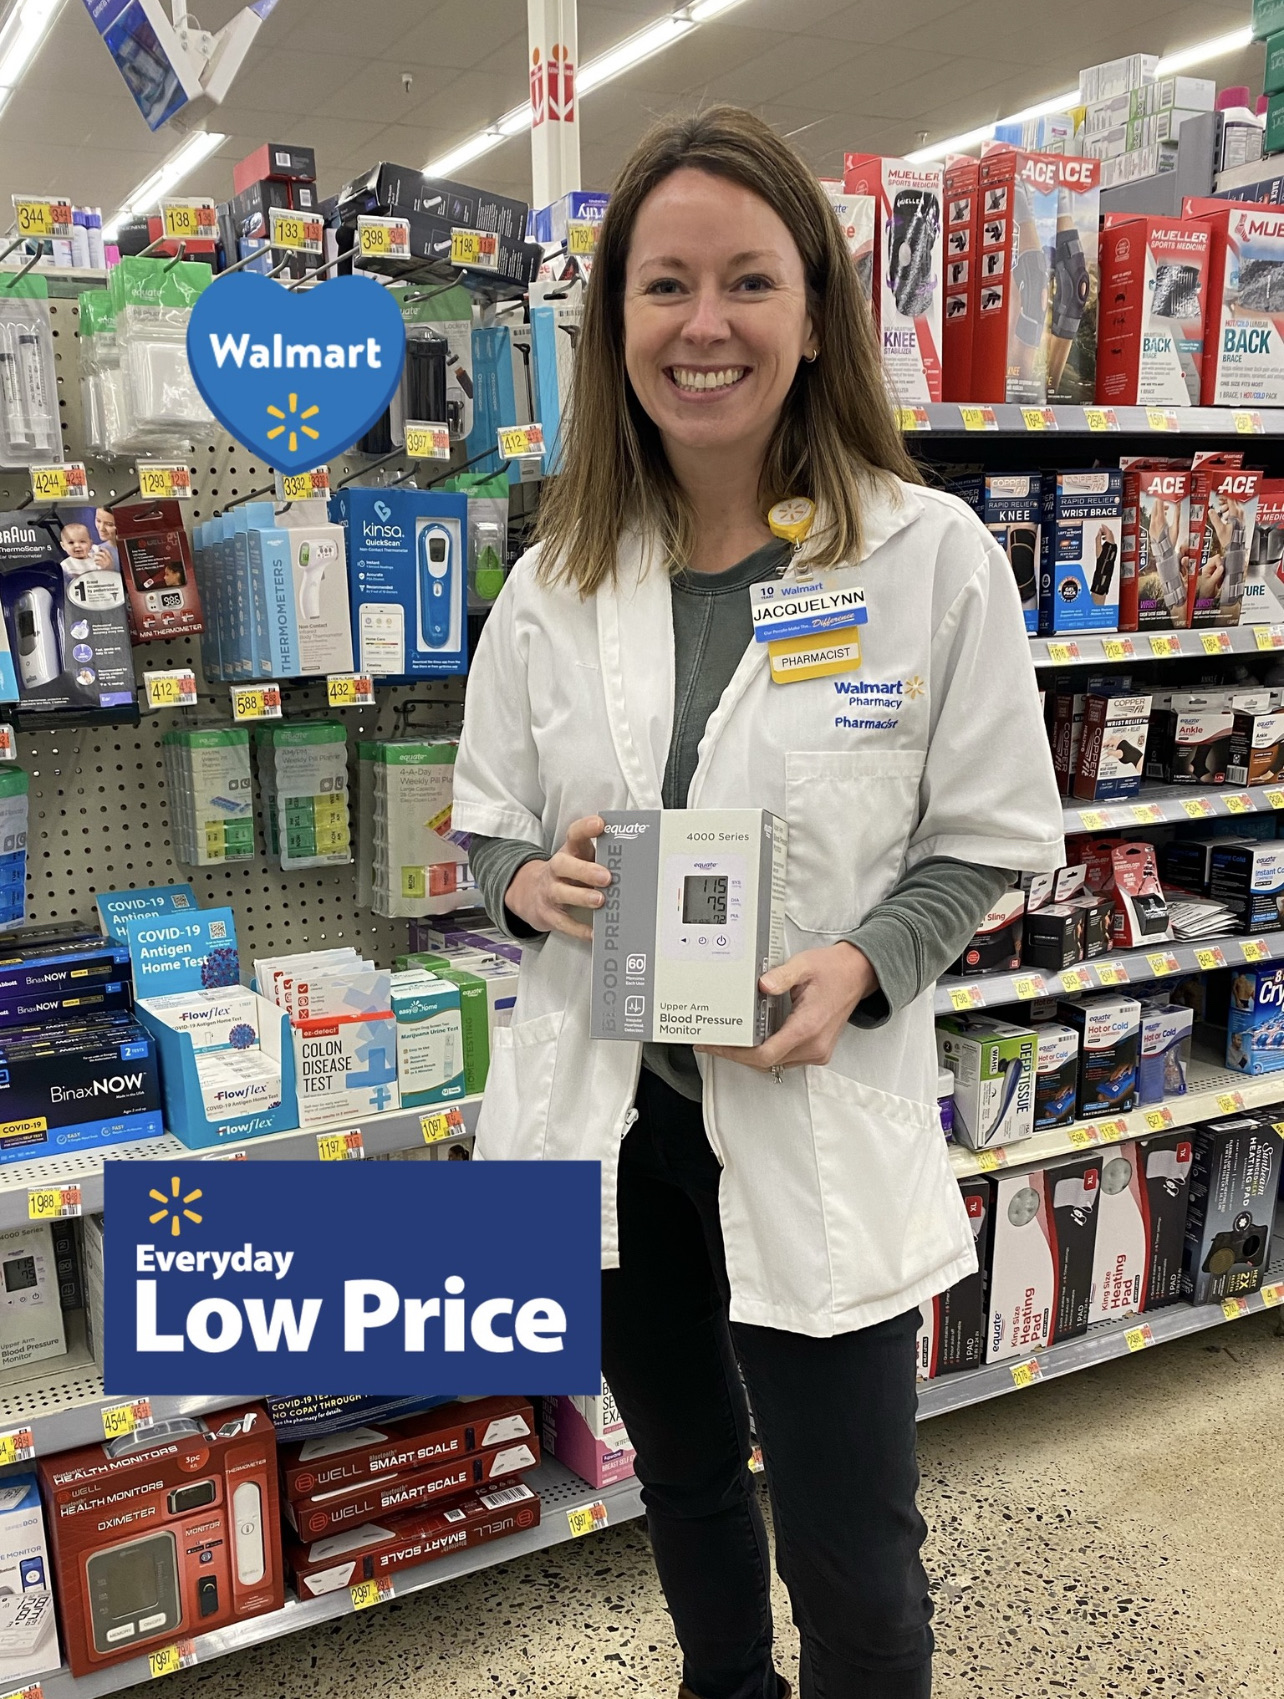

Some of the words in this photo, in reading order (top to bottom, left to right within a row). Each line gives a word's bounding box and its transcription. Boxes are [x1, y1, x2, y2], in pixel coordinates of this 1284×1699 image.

[888, 169, 939, 181] MUELLER
[1021, 160, 1055, 185] ACE
[1151, 229, 1208, 244] MUELLER
[1151, 241, 1175, 249] SPORTS
[1176, 242, 1206, 252] MEDICINE
[884, 332, 916, 348] KNEE
[1143, 338, 1172, 353] BACK
[1224, 328, 1272, 354] BACK
[1222, 354, 1242, 363] BRACE
[992, 479, 1027, 487] COPPER
[1148, 477, 1185, 494] ACE
[1218, 476, 1258, 494] ACE
[1000, 510, 1030, 521] KNEE
[1062, 509, 1088, 517] WRIST
[1091, 508, 1117, 516] BRACE
[366, 539, 400, 547] QuickScan
[760, 587, 774, 595] 10
[781, 582, 823, 597] Walmart
[754, 591, 865, 621] JACQUELYNN
[273, 559, 291, 672] THERMOMETERS
[155, 623, 202, 636] THERMOMETER
[782, 647, 851, 668] PHARMACIST
[834, 680, 903, 695] Walmart
[849, 697, 903, 710] Pharmacy
[1114, 698, 1145, 707] COPPER
[834, 717, 899, 730] Pharmacist
[1180, 726, 1203, 734] Ankle
[1061, 722, 1071, 773] COPPER
[1089, 727, 1102, 778] COPPER
[604, 822, 648, 837] equate
[687, 832, 715, 841] 4000
[718, 832, 749, 841] Series
[108, 897, 164, 912] COVID-19
[707, 896, 727, 912] 75
[987, 912, 1005, 922] Sling
[137, 925, 201, 943] COVID-19
[140, 943, 192, 960] Antigen
[141, 957, 179, 975] Home
[182, 955, 209, 969] Test
[629, 958, 644, 970] 60
[26, 972, 66, 984] BinaxNOW
[18, 1001, 58, 1014] BinaxNOW
[182, 1007, 230, 1021] Flowflex
[660, 1003, 687, 1012] Upper
[690, 1003, 709, 1011] Arm
[660, 1014, 692, 1024] Blood
[696, 1015, 743, 1026] Pressure
[1088, 1025, 1102, 1034] Hot
[1112, 1022, 1128, 1031] Cold
[659, 1026, 701, 1035] Monitor
[1144, 1034, 1155, 1042] Hot
[1163, 1028, 1176, 1037] Cold
[302, 1040, 342, 1058] COLON
[1019, 1042, 1032, 1071] DEEP
[303, 1056, 352, 1076] DISEASE
[1038, 1054, 1047, 1062] Hot
[51, 1073, 143, 1103] BinaxNOW
[303, 1075, 333, 1092] TEST
[216, 1084, 266, 1101] Flowflex
[1017, 1073, 1030, 1115] TISSUE
[3, 1121, 41, 1134] COVID-19
[218, 1118, 273, 1136] Flowflex
[1180, 1147, 1186, 1158] XL
[1245, 1137, 1257, 1185] HEATING
[1257, 1142, 1274, 1196] Sunbeam
[1087, 1174, 1093, 1185] XL
[1243, 1186, 1251, 1207] PAD
[970, 1201, 977, 1212] XL
[1111, 1254, 1126, 1310] Heating
[1239, 1271, 1249, 1289] 2X
[1122, 1279, 1133, 1306] Pad
[1020, 1287, 1035, 1345] Heating
[993, 1313, 1002, 1352] equate
[1031, 1313, 1042, 1342] Pad
[2, 1346, 25, 1358] Blood
[27, 1338, 59, 1354] Pressure
[22, 1337, 35, 1345] Arm
[2, 1352, 32, 1365] Monitor
[271, 1396, 312, 1411] COVID-19
[272, 1411, 287, 1420] NO
[290, 1404, 318, 1417] COPAY
[185, 1454, 200, 1464] 3pc
[370, 1452, 415, 1472] SMART
[417, 1440, 459, 1459] SCALE
[54, 1465, 108, 1485] HEALTH
[110, 1445, 178, 1471] MONITORS
[225, 1458, 267, 1475] THERMOMETER
[381, 1487, 426, 1507] SMART
[427, 1472, 467, 1493] SCALE
[61, 1497, 105, 1517] HEALTH
[107, 1480, 164, 1504] MONITORS
[98, 1507, 156, 1531] OXIMETER
[185, 1520, 221, 1536] MONITOR
[424, 1530, 467, 1552] SMART
[7, 1546, 41, 1559] MONITOR
[381, 1546, 421, 1566] SCALE
